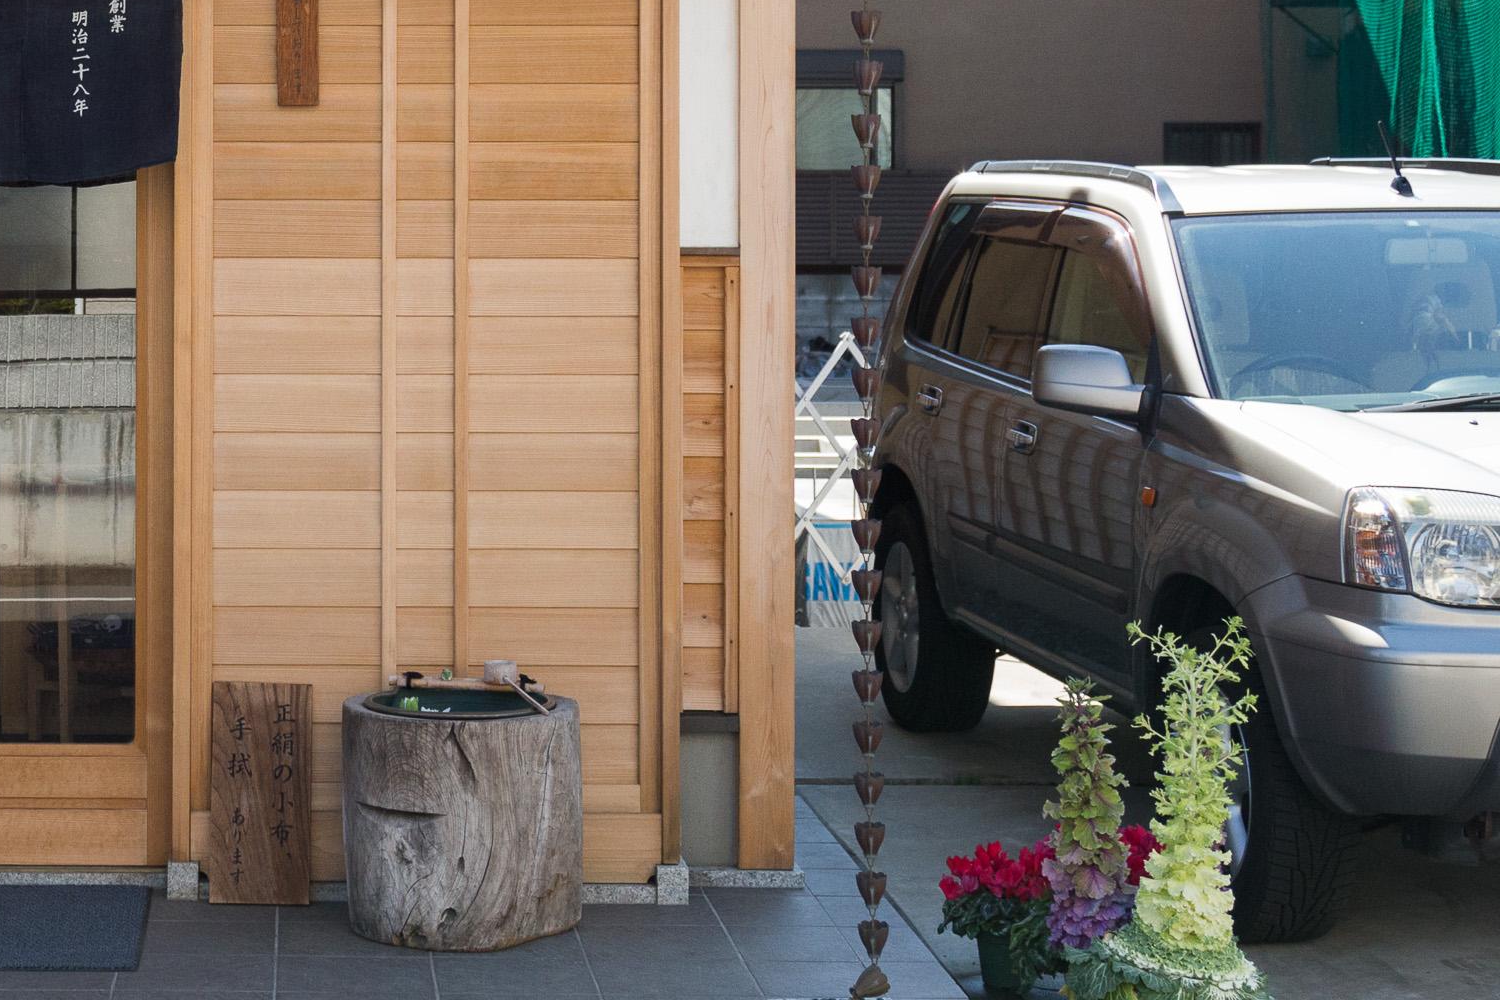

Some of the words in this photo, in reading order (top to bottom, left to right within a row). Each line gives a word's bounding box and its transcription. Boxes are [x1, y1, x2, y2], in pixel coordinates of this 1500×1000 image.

[71, 10, 91, 117] 明治二十八年
